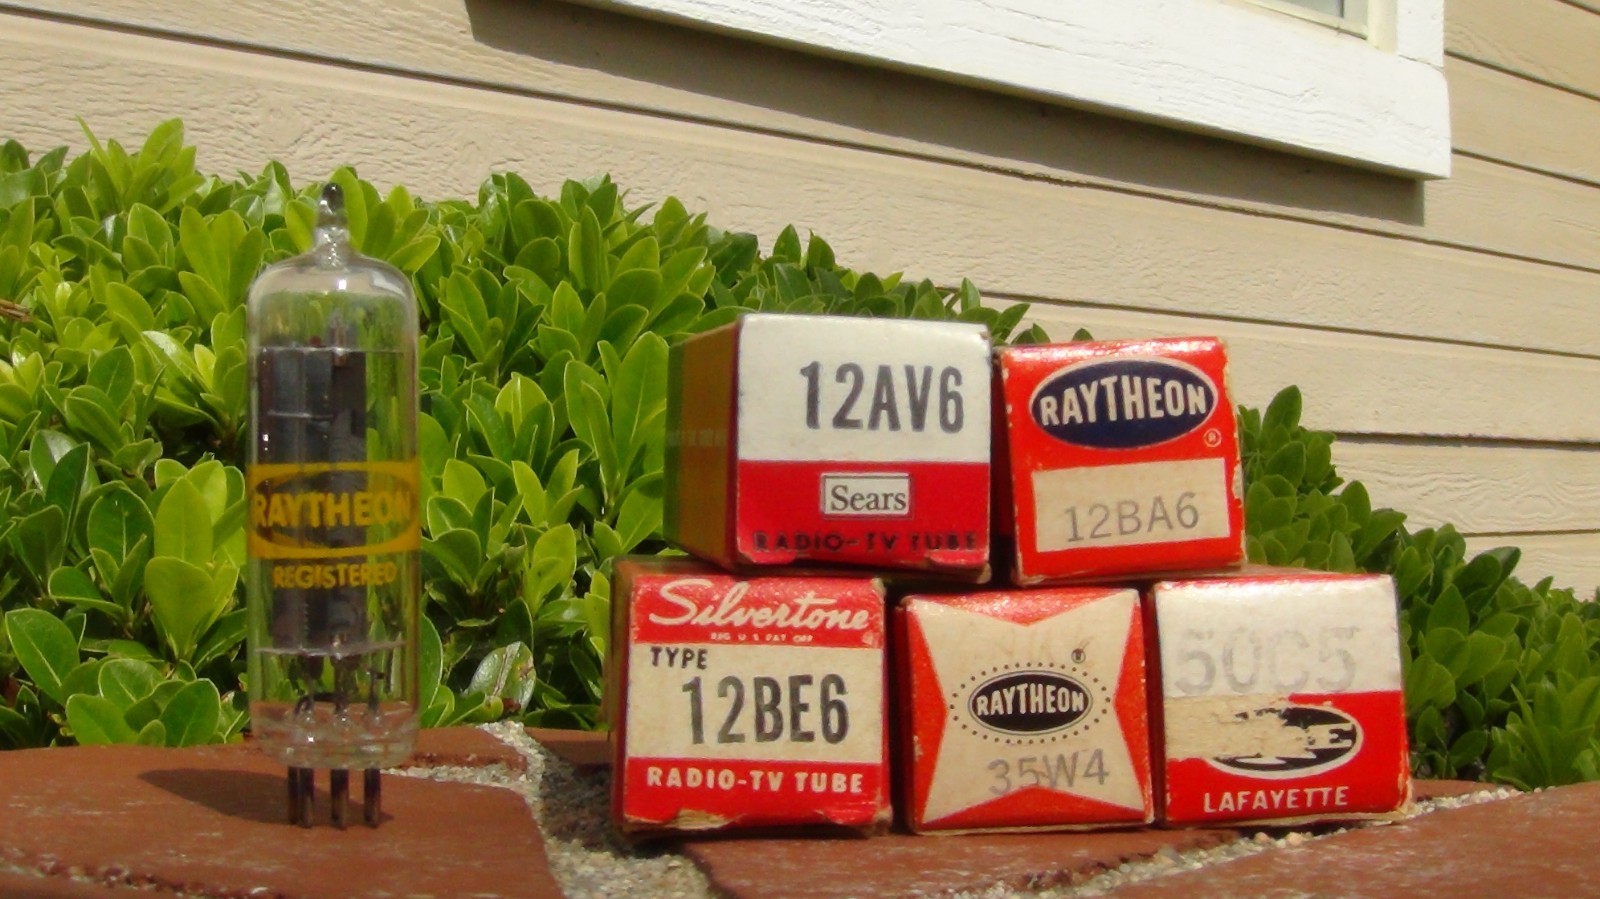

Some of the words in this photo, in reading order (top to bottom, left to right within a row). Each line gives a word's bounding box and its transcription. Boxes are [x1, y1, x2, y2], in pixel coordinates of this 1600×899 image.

[800, 361, 964, 434] 12AV6
[1039, 374, 1207, 426] RAYTHEON
[254, 491, 412, 528] RAYTHEON
[830, 485, 907, 512] Sears
[1064, 492, 1200, 542] 12BA6
[910, 532, 978, 550] TUBE
[272, 561, 398, 588] REGISTERED
[649, 578, 869, 630] Silvertone
[650, 647, 709, 670] TYPE
[1175, 626, 1360, 695] 50C5
[682, 674, 850, 745] 12BE6
[976, 682, 1085, 716] RAYTHEON
[646, 766, 784, 792] RADIO-TV
[794, 772, 864, 794] TUBE
[986, 748, 1110, 797] 35W4
[1203, 785, 1350, 814] LAFAYETTE
